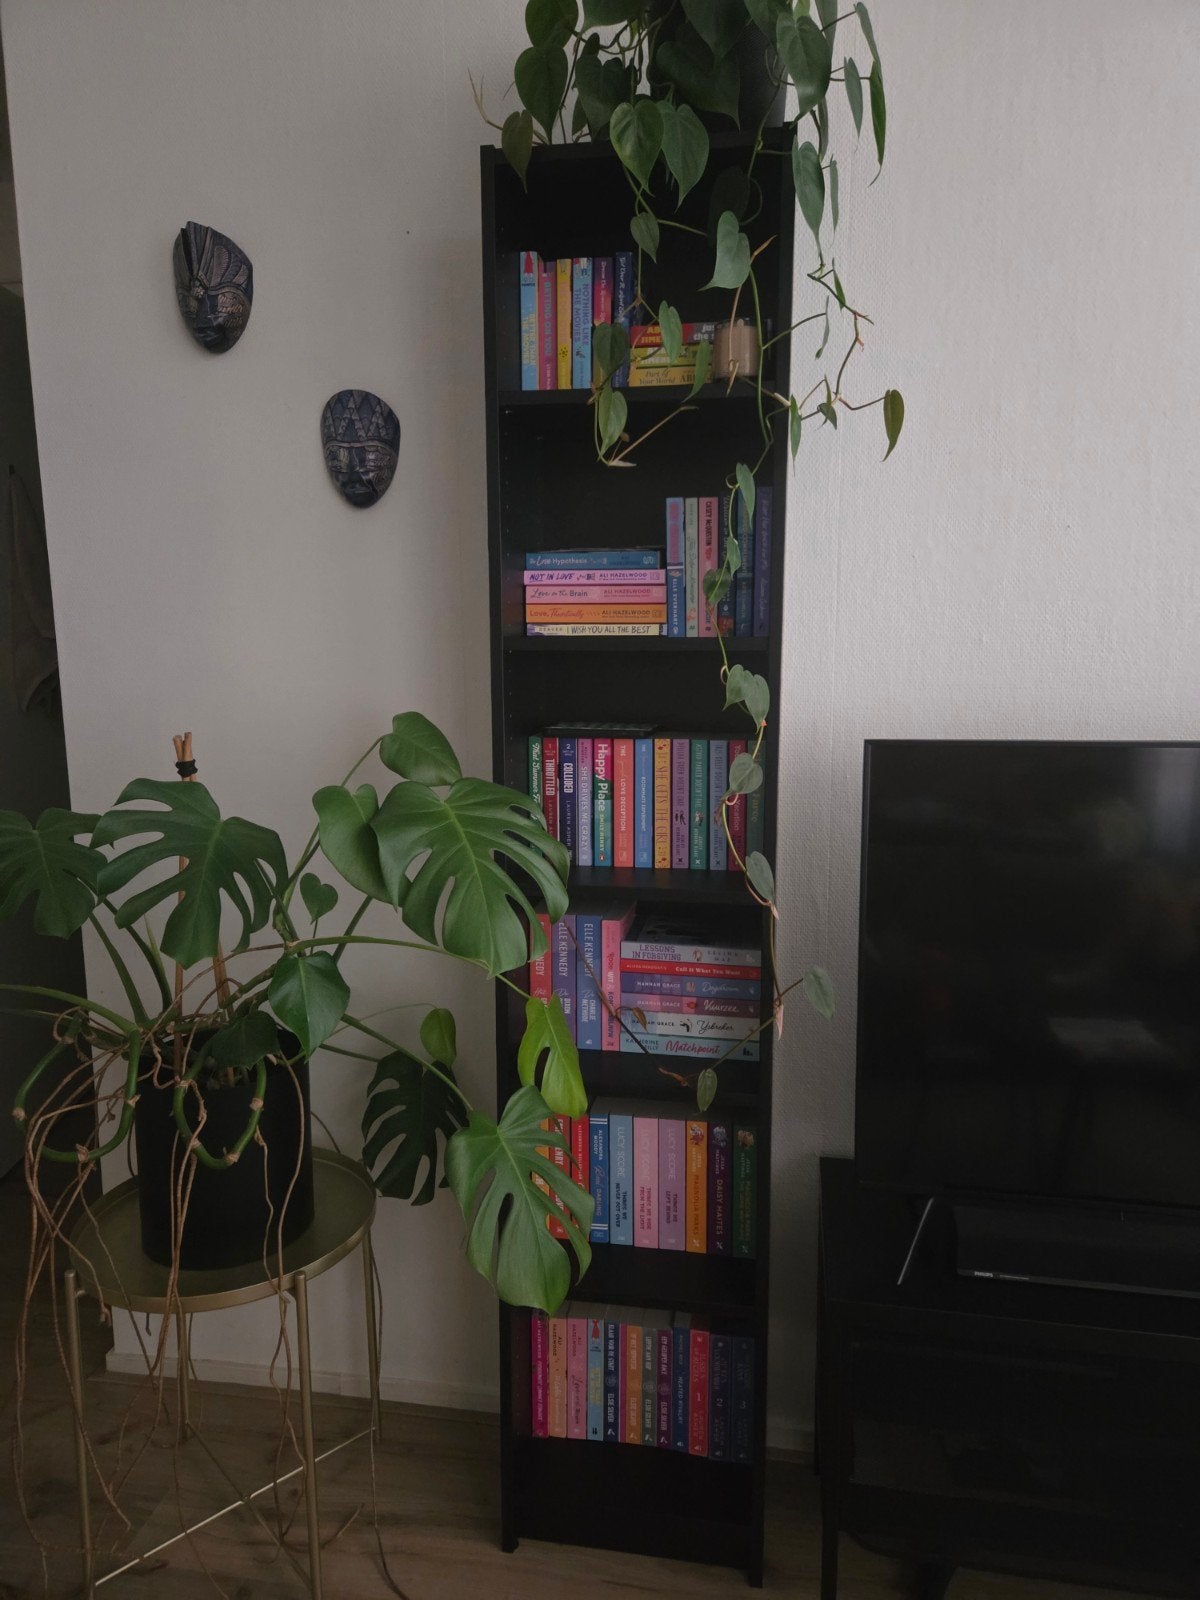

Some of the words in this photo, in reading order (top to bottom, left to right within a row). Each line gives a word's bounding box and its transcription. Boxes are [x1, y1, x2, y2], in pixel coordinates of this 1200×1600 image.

[582, 284, 590, 324] NOTHING
[544, 322, 552, 334] ON
[582, 327, 590, 346] LIKE
[544, 337, 552, 356] YOU
[552, 558, 588, 566] Hypothesis
[529, 574, 544, 582] NOT
[571, 626, 584, 634] WISH
[585, 626, 604, 634] YOU
[604, 626, 616, 634] ALL
[618, 626, 630, 634] THE
[631, 626, 650, 634] BEST
[532, 742, 540, 762] That
[596, 744, 608, 780] Happy
[694, 762, 702, 778] PARKER
[532, 762, 540, 794] Summer
[546, 758, 554, 796] THROTTLED
[564, 762, 574, 793] COLLIDED
[656, 766, 668, 780] SHE
[598, 782, 609, 812] Place
[656, 784, 668, 806] GETS
[581, 811, 588, 823] ME
[656, 808, 668, 821] THE
[558, 922, 568, 941] ELLE
[584, 923, 594, 942] ELLE
[639, 944, 676, 953] LESSONS
[642, 952, 682, 961] FORGIVING
[558, 942, 568, 977] KENNEDY
[584, 942, 594, 978] KENNEDY
[665, 1042, 719, 1054] Matchpoint
[617, 1127, 626, 1148] LUCY
[667, 1128, 677, 1150] LUCY
[617, 1151, 626, 1178] SCORE
[667, 1152, 677, 1182] SCORE
[716, 1179, 724, 1204] DAISY
[716, 1205, 724, 1236] HAITES
[660, 1402, 668, 1414] ELSIE
